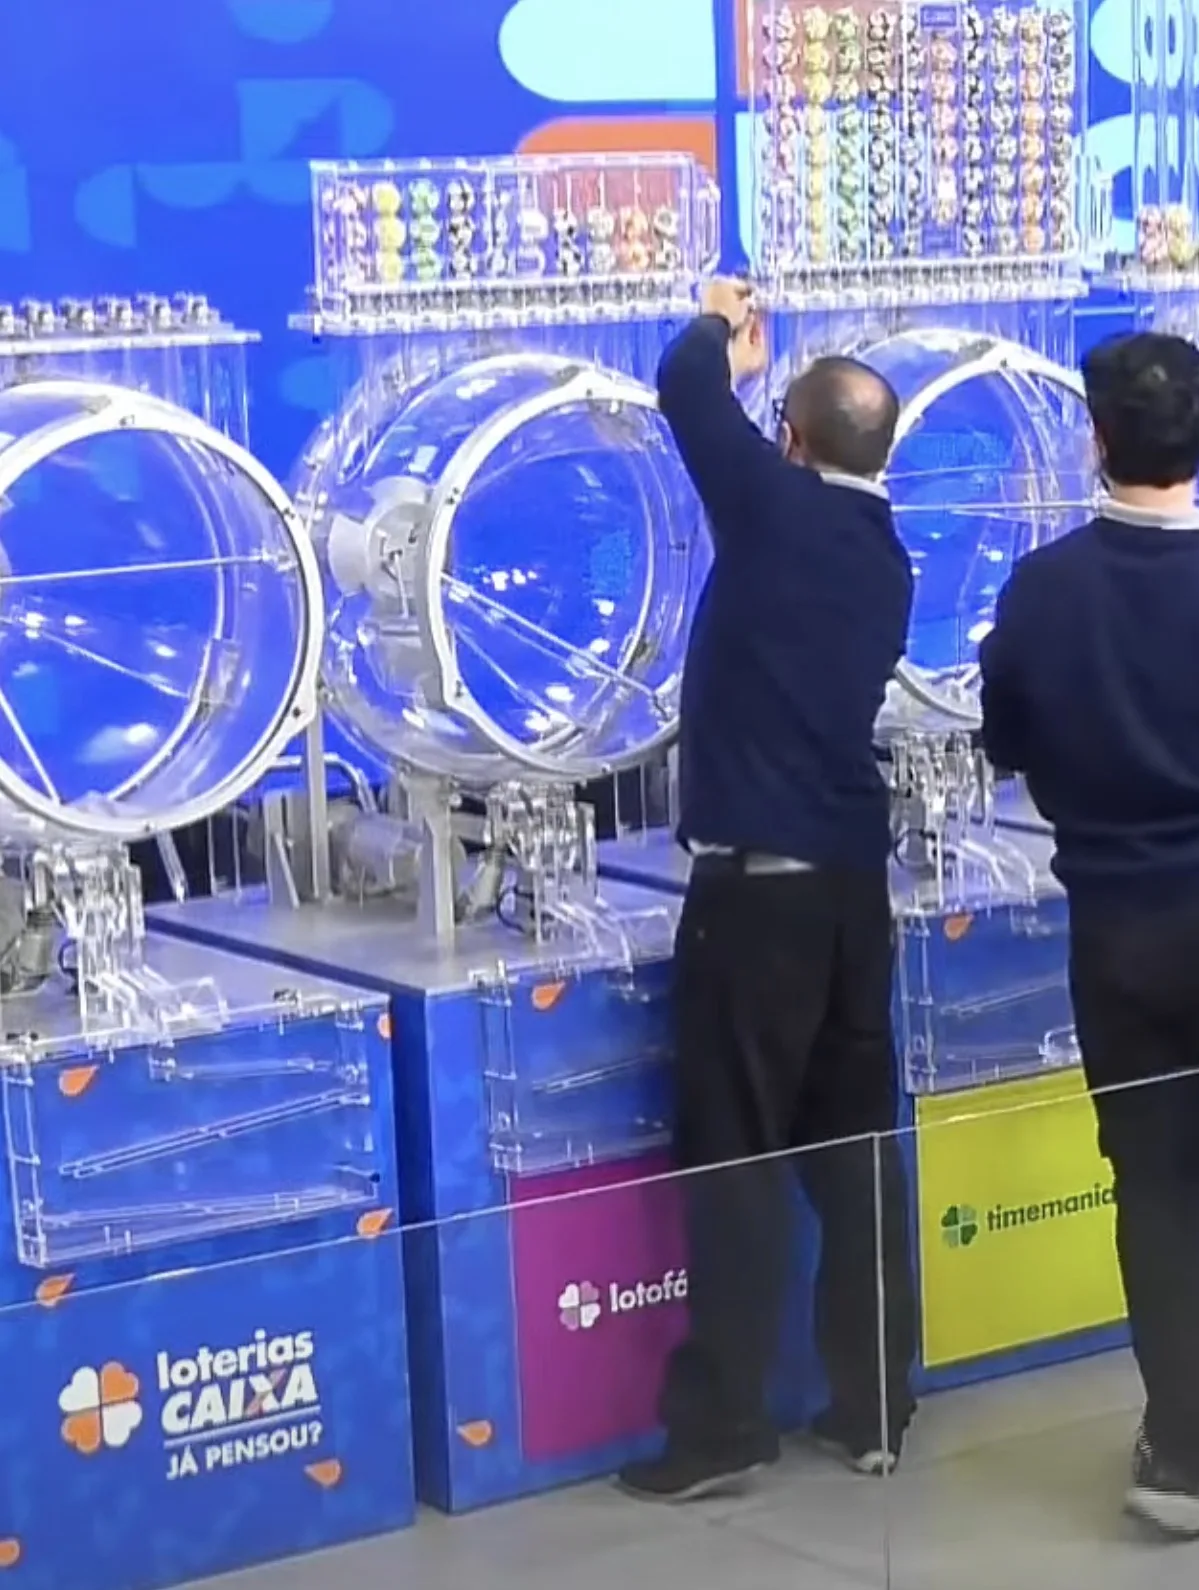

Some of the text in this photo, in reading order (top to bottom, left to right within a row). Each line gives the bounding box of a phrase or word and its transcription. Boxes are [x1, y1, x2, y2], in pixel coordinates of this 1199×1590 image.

[609, 1268, 687, 1313] lotofá
[156, 1328, 314, 1391] loterias
[161, 1364, 319, 1435] CAIXA
[166, 1423, 323, 1480] JÁ PENSOU?
